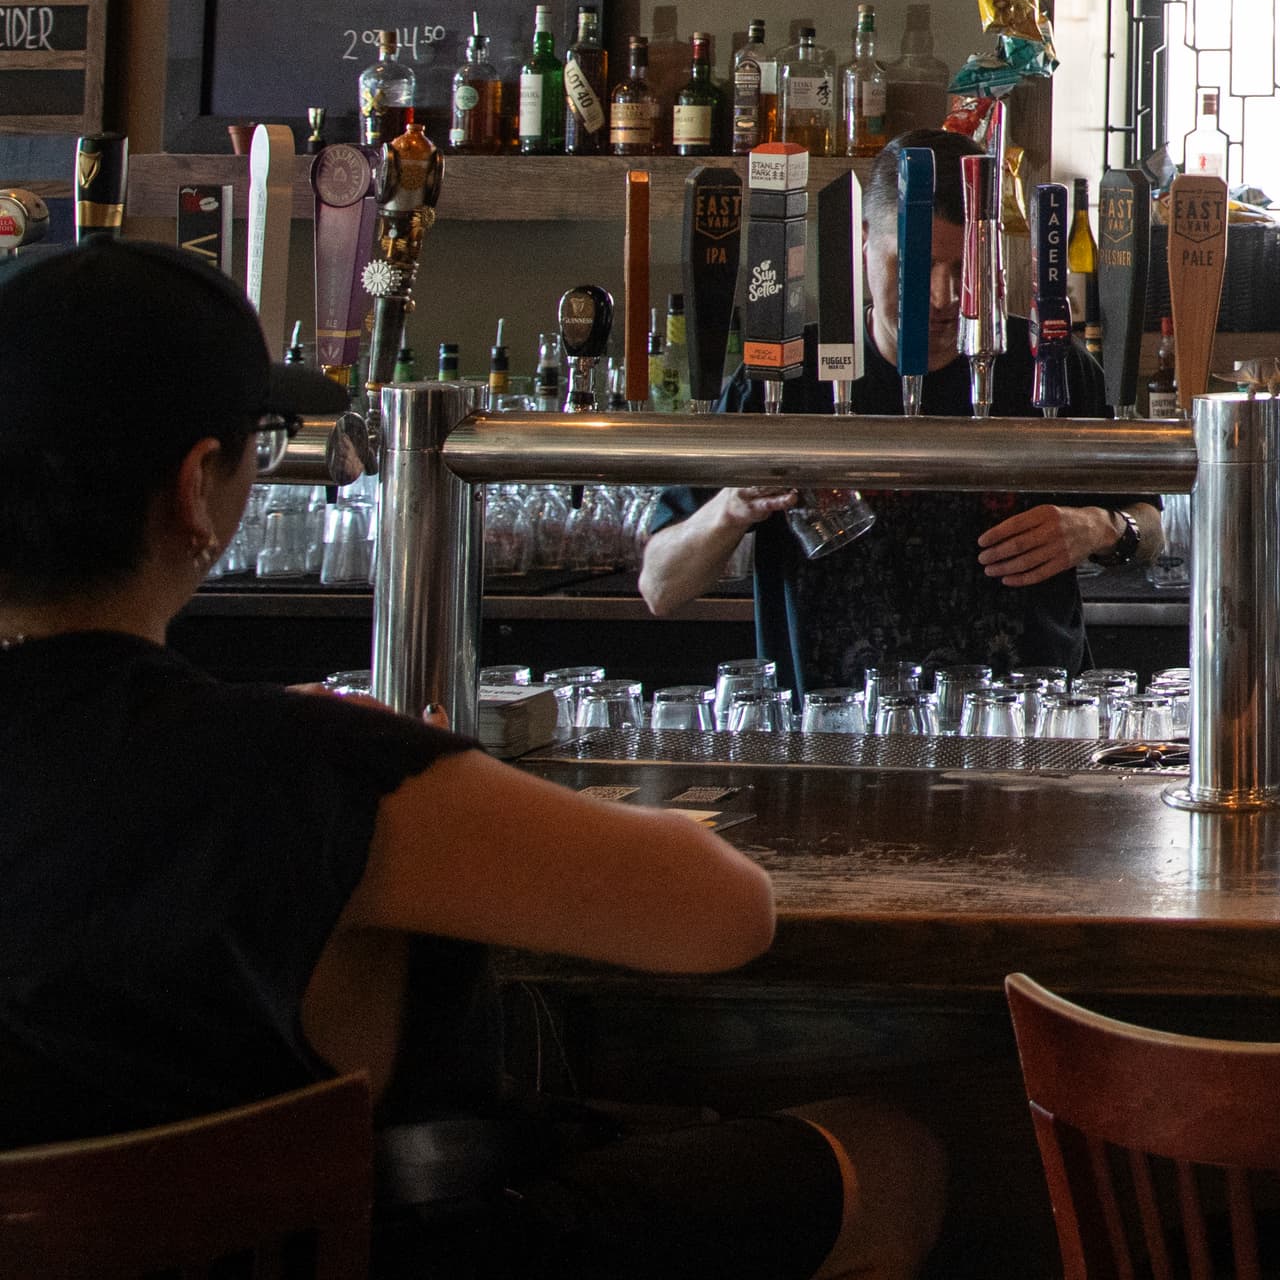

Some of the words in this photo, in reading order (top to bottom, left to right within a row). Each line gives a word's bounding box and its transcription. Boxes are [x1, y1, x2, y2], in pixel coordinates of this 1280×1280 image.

[565, 67, 585, 90] LOT
[576, 90, 594, 110] 40
[752, 161, 785, 170] STANLEY
[752, 169, 771, 177] PARK
[696, 196, 742, 215] EAST
[1100, 198, 1134, 218] EAST
[1174, 200, 1223, 218] EAST
[708, 216, 730, 228] VAN
[1107, 221, 1125, 233] VAN
[1187, 221, 1211, 233] VAN
[1047, 193, 1059, 282] LAGER
[706, 247, 727, 265] IPA
[1100, 249, 1132, 267] PILSNER
[1182, 249, 1214, 267] PALE
[752, 265, 777, 285] Sun
[749, 280, 783, 302] Setter
[821, 356, 852, 366] FUGGLES
